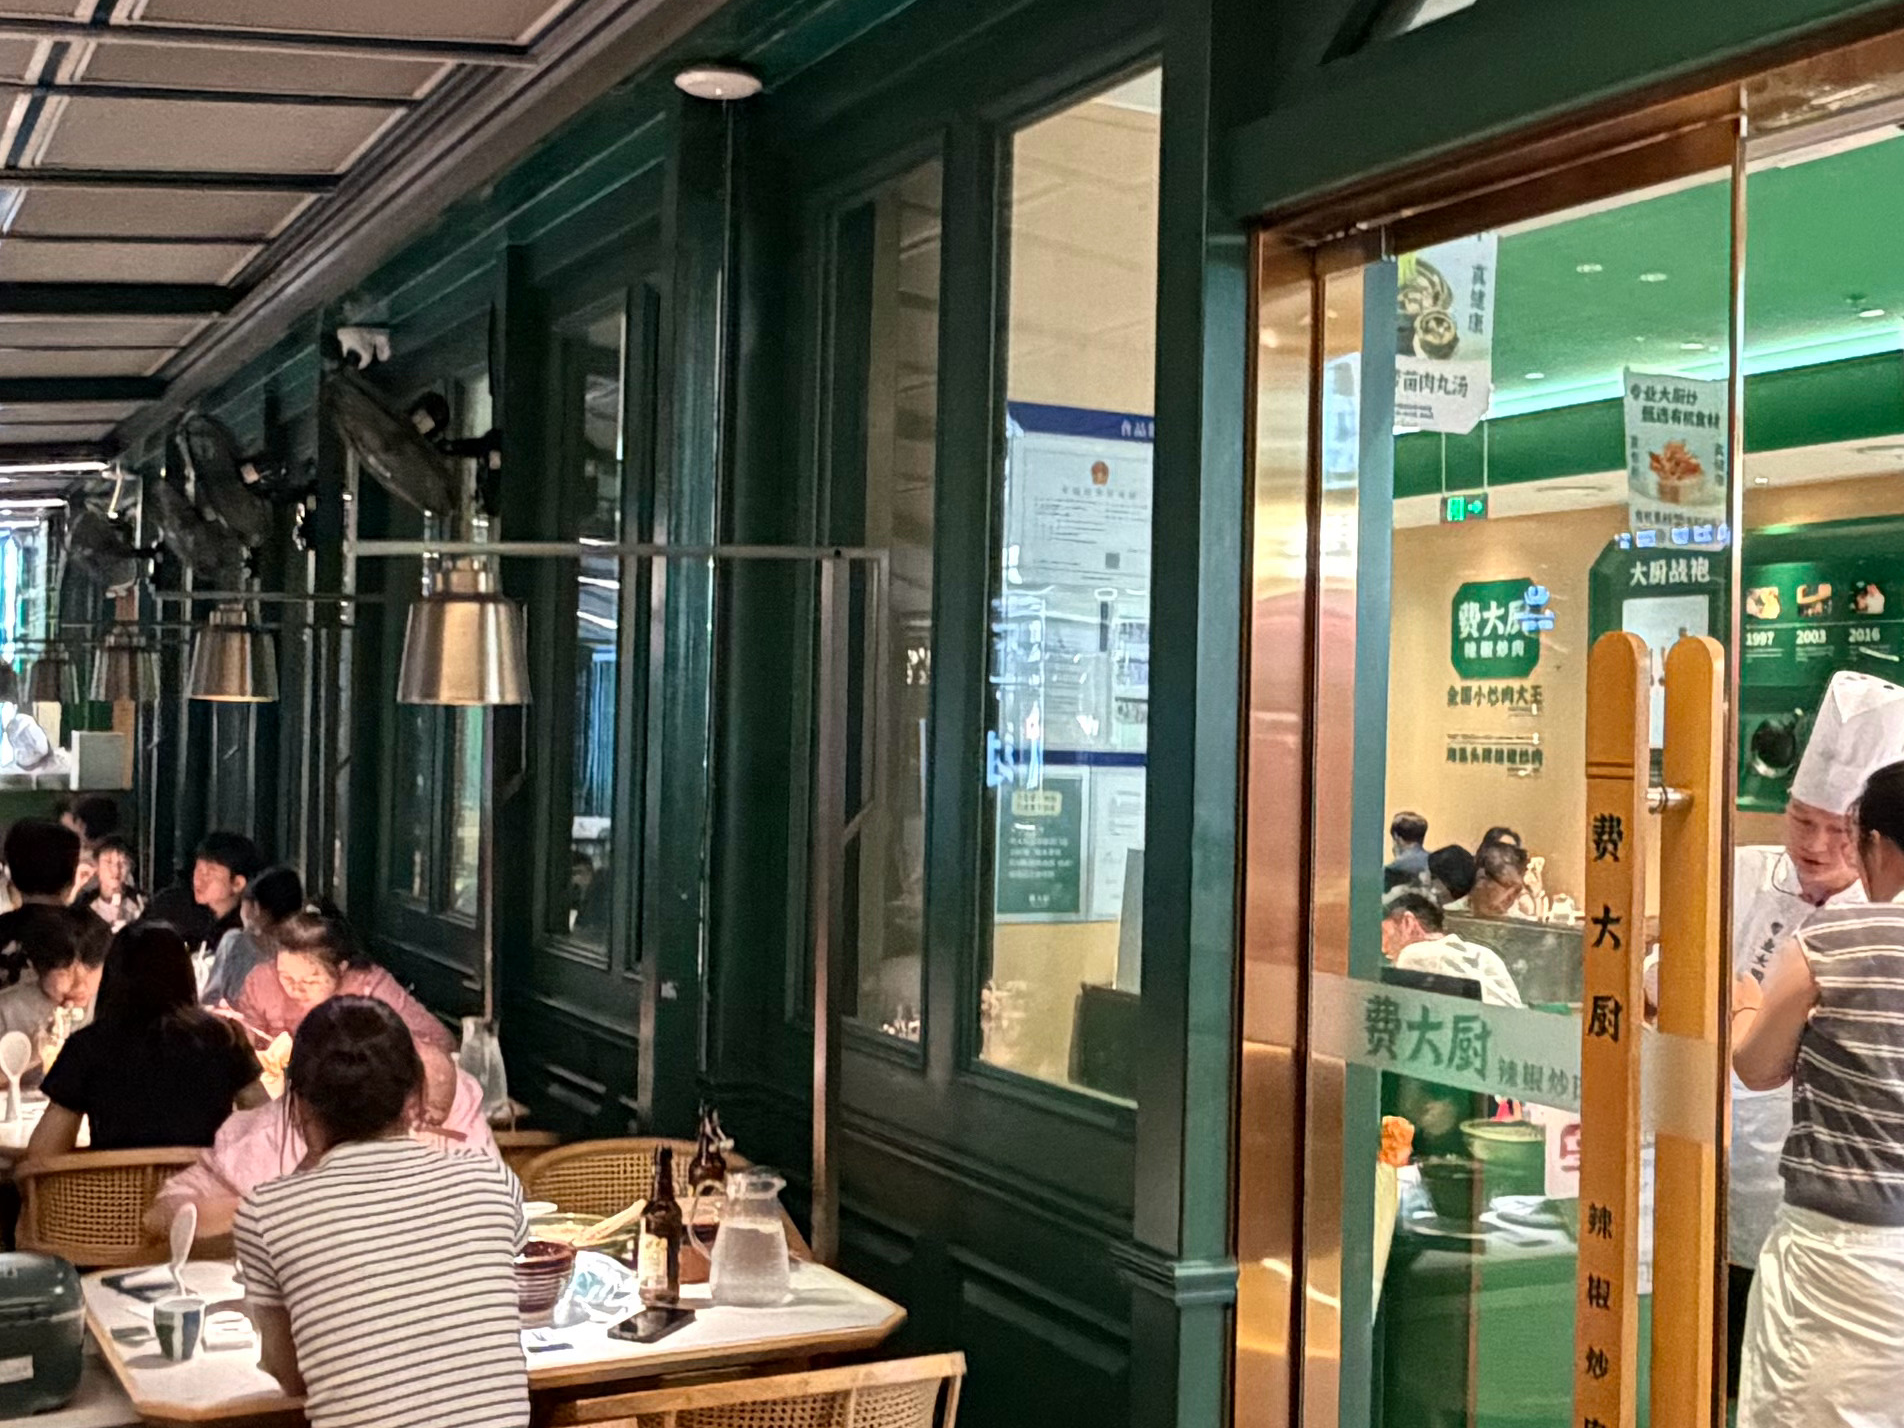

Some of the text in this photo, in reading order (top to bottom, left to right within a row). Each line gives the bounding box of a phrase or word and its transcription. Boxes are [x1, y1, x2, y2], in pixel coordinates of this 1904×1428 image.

[1746, 631, 1775, 647] 1997
[1796, 629, 1827, 645] 2003
[1848, 627, 1881, 643] 2016
[1588, 813, 1623, 1042] 费大厨
[1365, 995, 1492, 1082] 费大厨
